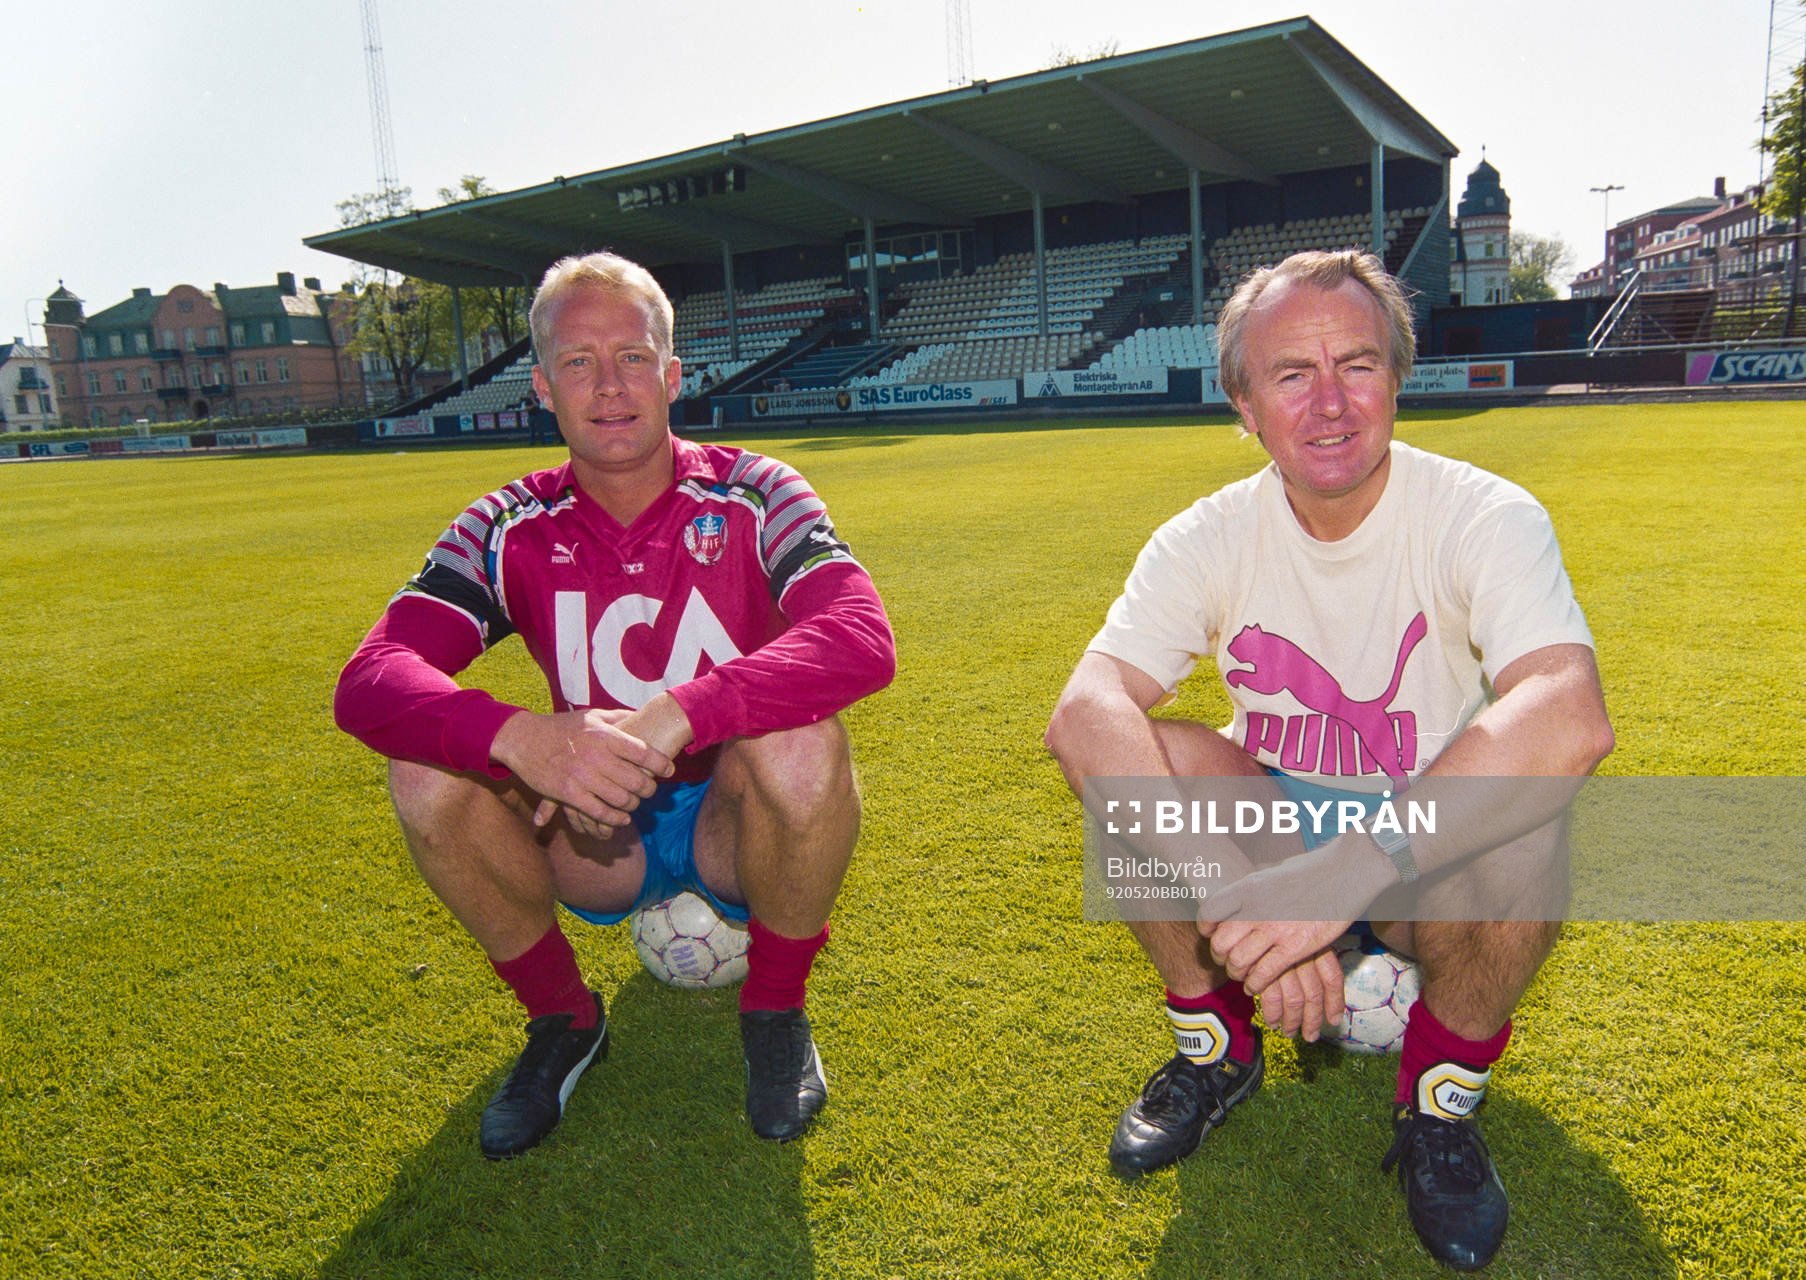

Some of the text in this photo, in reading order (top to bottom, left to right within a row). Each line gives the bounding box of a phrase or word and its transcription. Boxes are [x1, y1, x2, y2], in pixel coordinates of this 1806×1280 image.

[1073, 372, 1118, 382] Elektriska
[1140, 380, 1153, 390] AB
[859, 384, 973, 405] SAS EuroClass
[555, 585, 745, 711] ICA
[1244, 711, 1418, 776] PUMA
